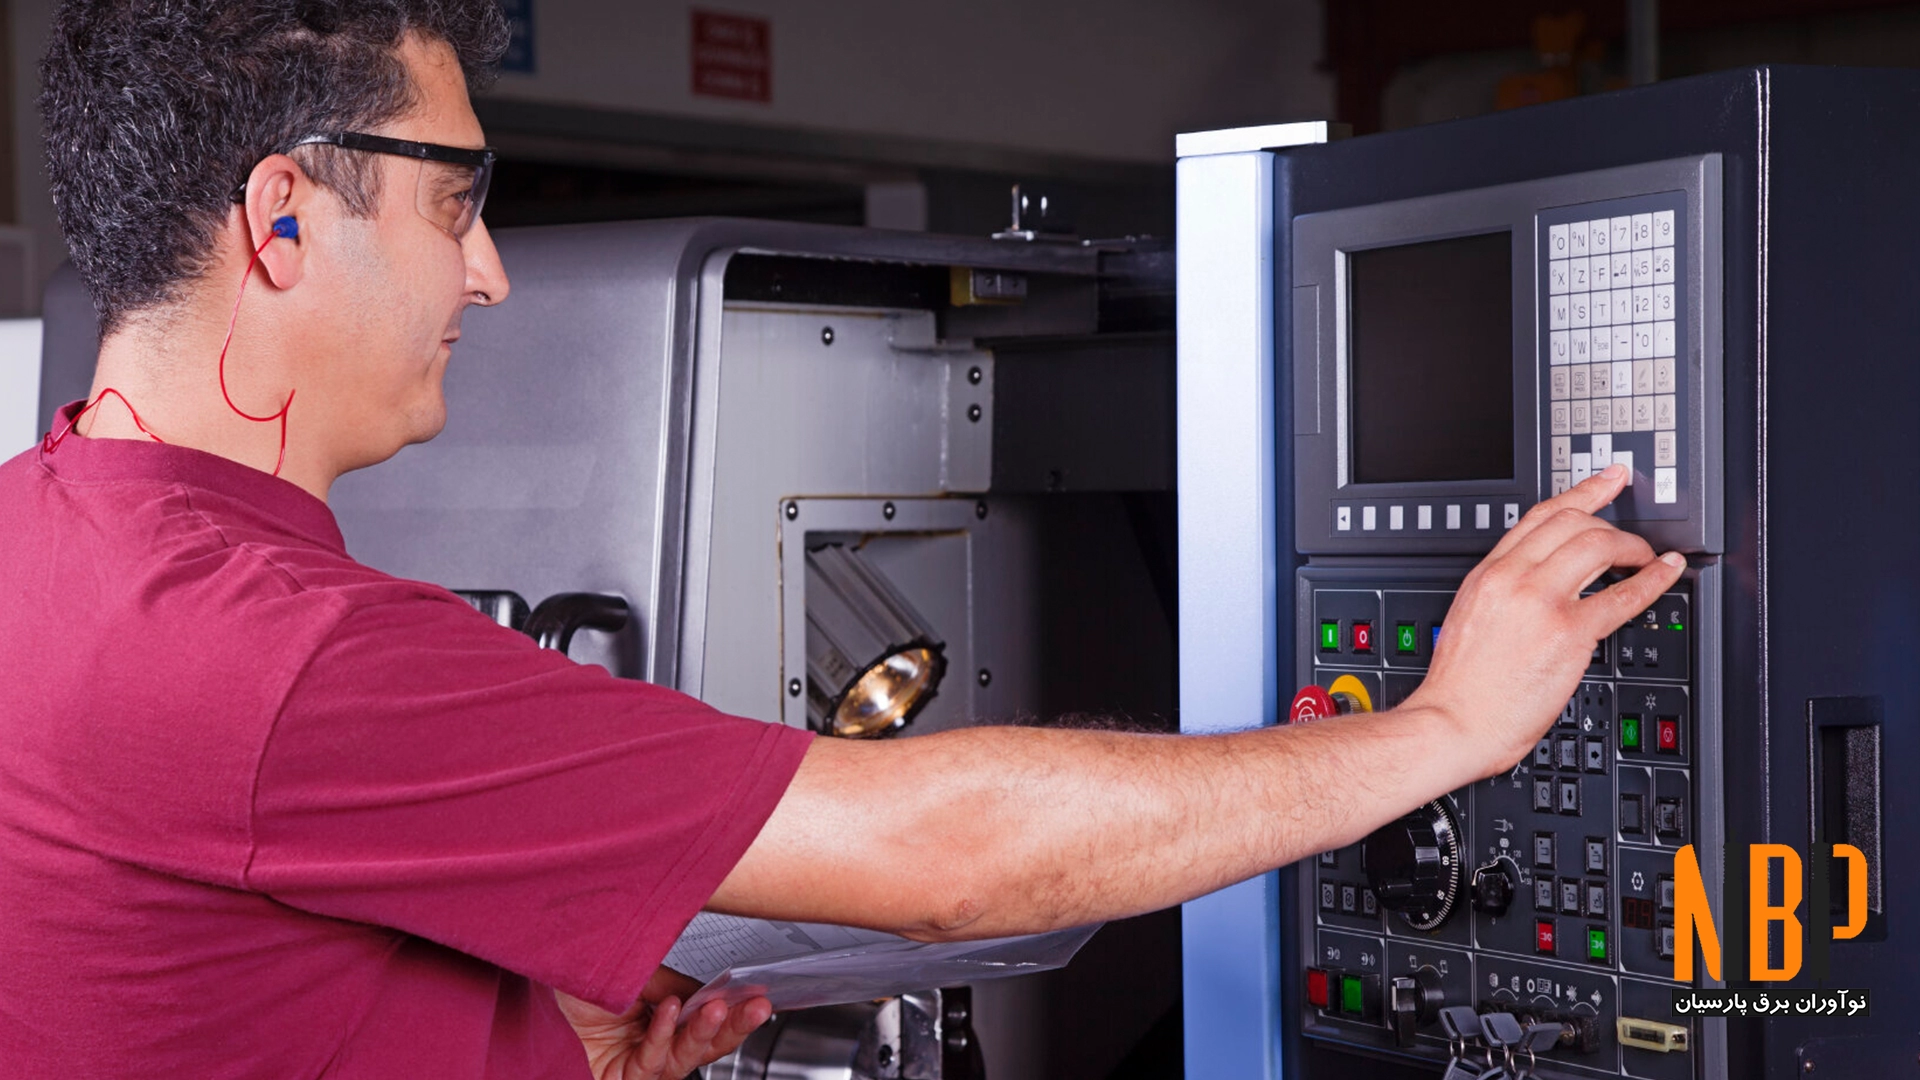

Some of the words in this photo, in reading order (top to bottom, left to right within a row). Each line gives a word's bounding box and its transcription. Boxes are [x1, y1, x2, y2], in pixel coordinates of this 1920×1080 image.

[1619, 227, 1627, 241] 7
[1641, 224, 1648, 239] 8
[1662, 222, 1670, 236] 9
[1577, 234, 1585, 248] N
[1598, 231, 1606, 246] G
[1620, 263, 1627, 277] 4
[1641, 260, 1649, 275] 5
[1662, 258, 1670, 273] 6
[1557, 272, 1565, 286] X
[1578, 270, 1585, 283] Z
[1598, 267, 1605, 282] F
[1621, 300, 1626, 313] 1
[1641, 297, 1649, 312] 2
[1663, 295, 1670, 310] 3
[1557, 307, 1566, 321] M
[1578, 305, 1586, 320] S
[1599, 303, 1606, 317] T
[1558, 343, 1565, 357] U
[1577, 340, 1587, 355] W
